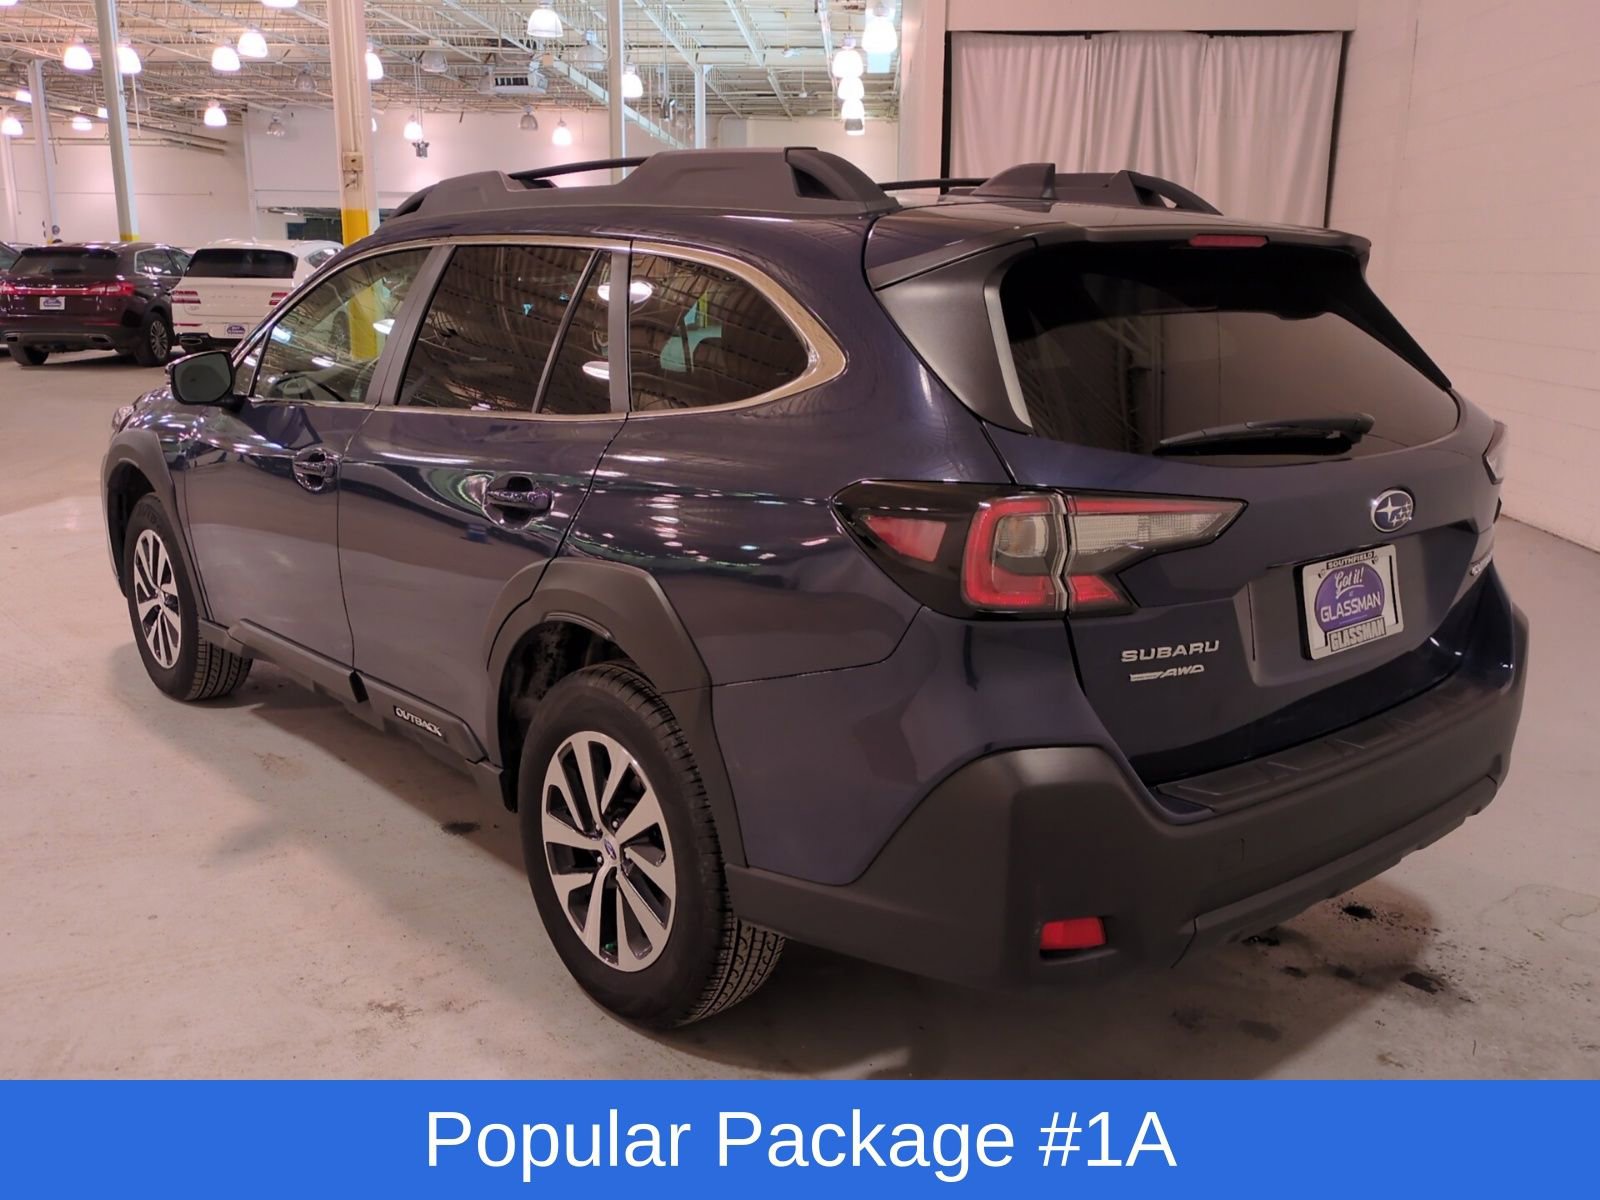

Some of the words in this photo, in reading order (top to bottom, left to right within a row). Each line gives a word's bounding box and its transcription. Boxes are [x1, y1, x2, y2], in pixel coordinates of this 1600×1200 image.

[1327, 552, 1373, 569] SOUTHFIELD
[1335, 570, 1353, 593] Got
[1353, 567, 1365, 585] it!
[1320, 592, 1381, 623] GLASSMAN
[1330, 617, 1385, 651] GLASSMAN
[1121, 640, 1220, 662] SUBARU
[1159, 664, 1205, 679] AWD
[394, 706, 442, 737] OUTBACK
